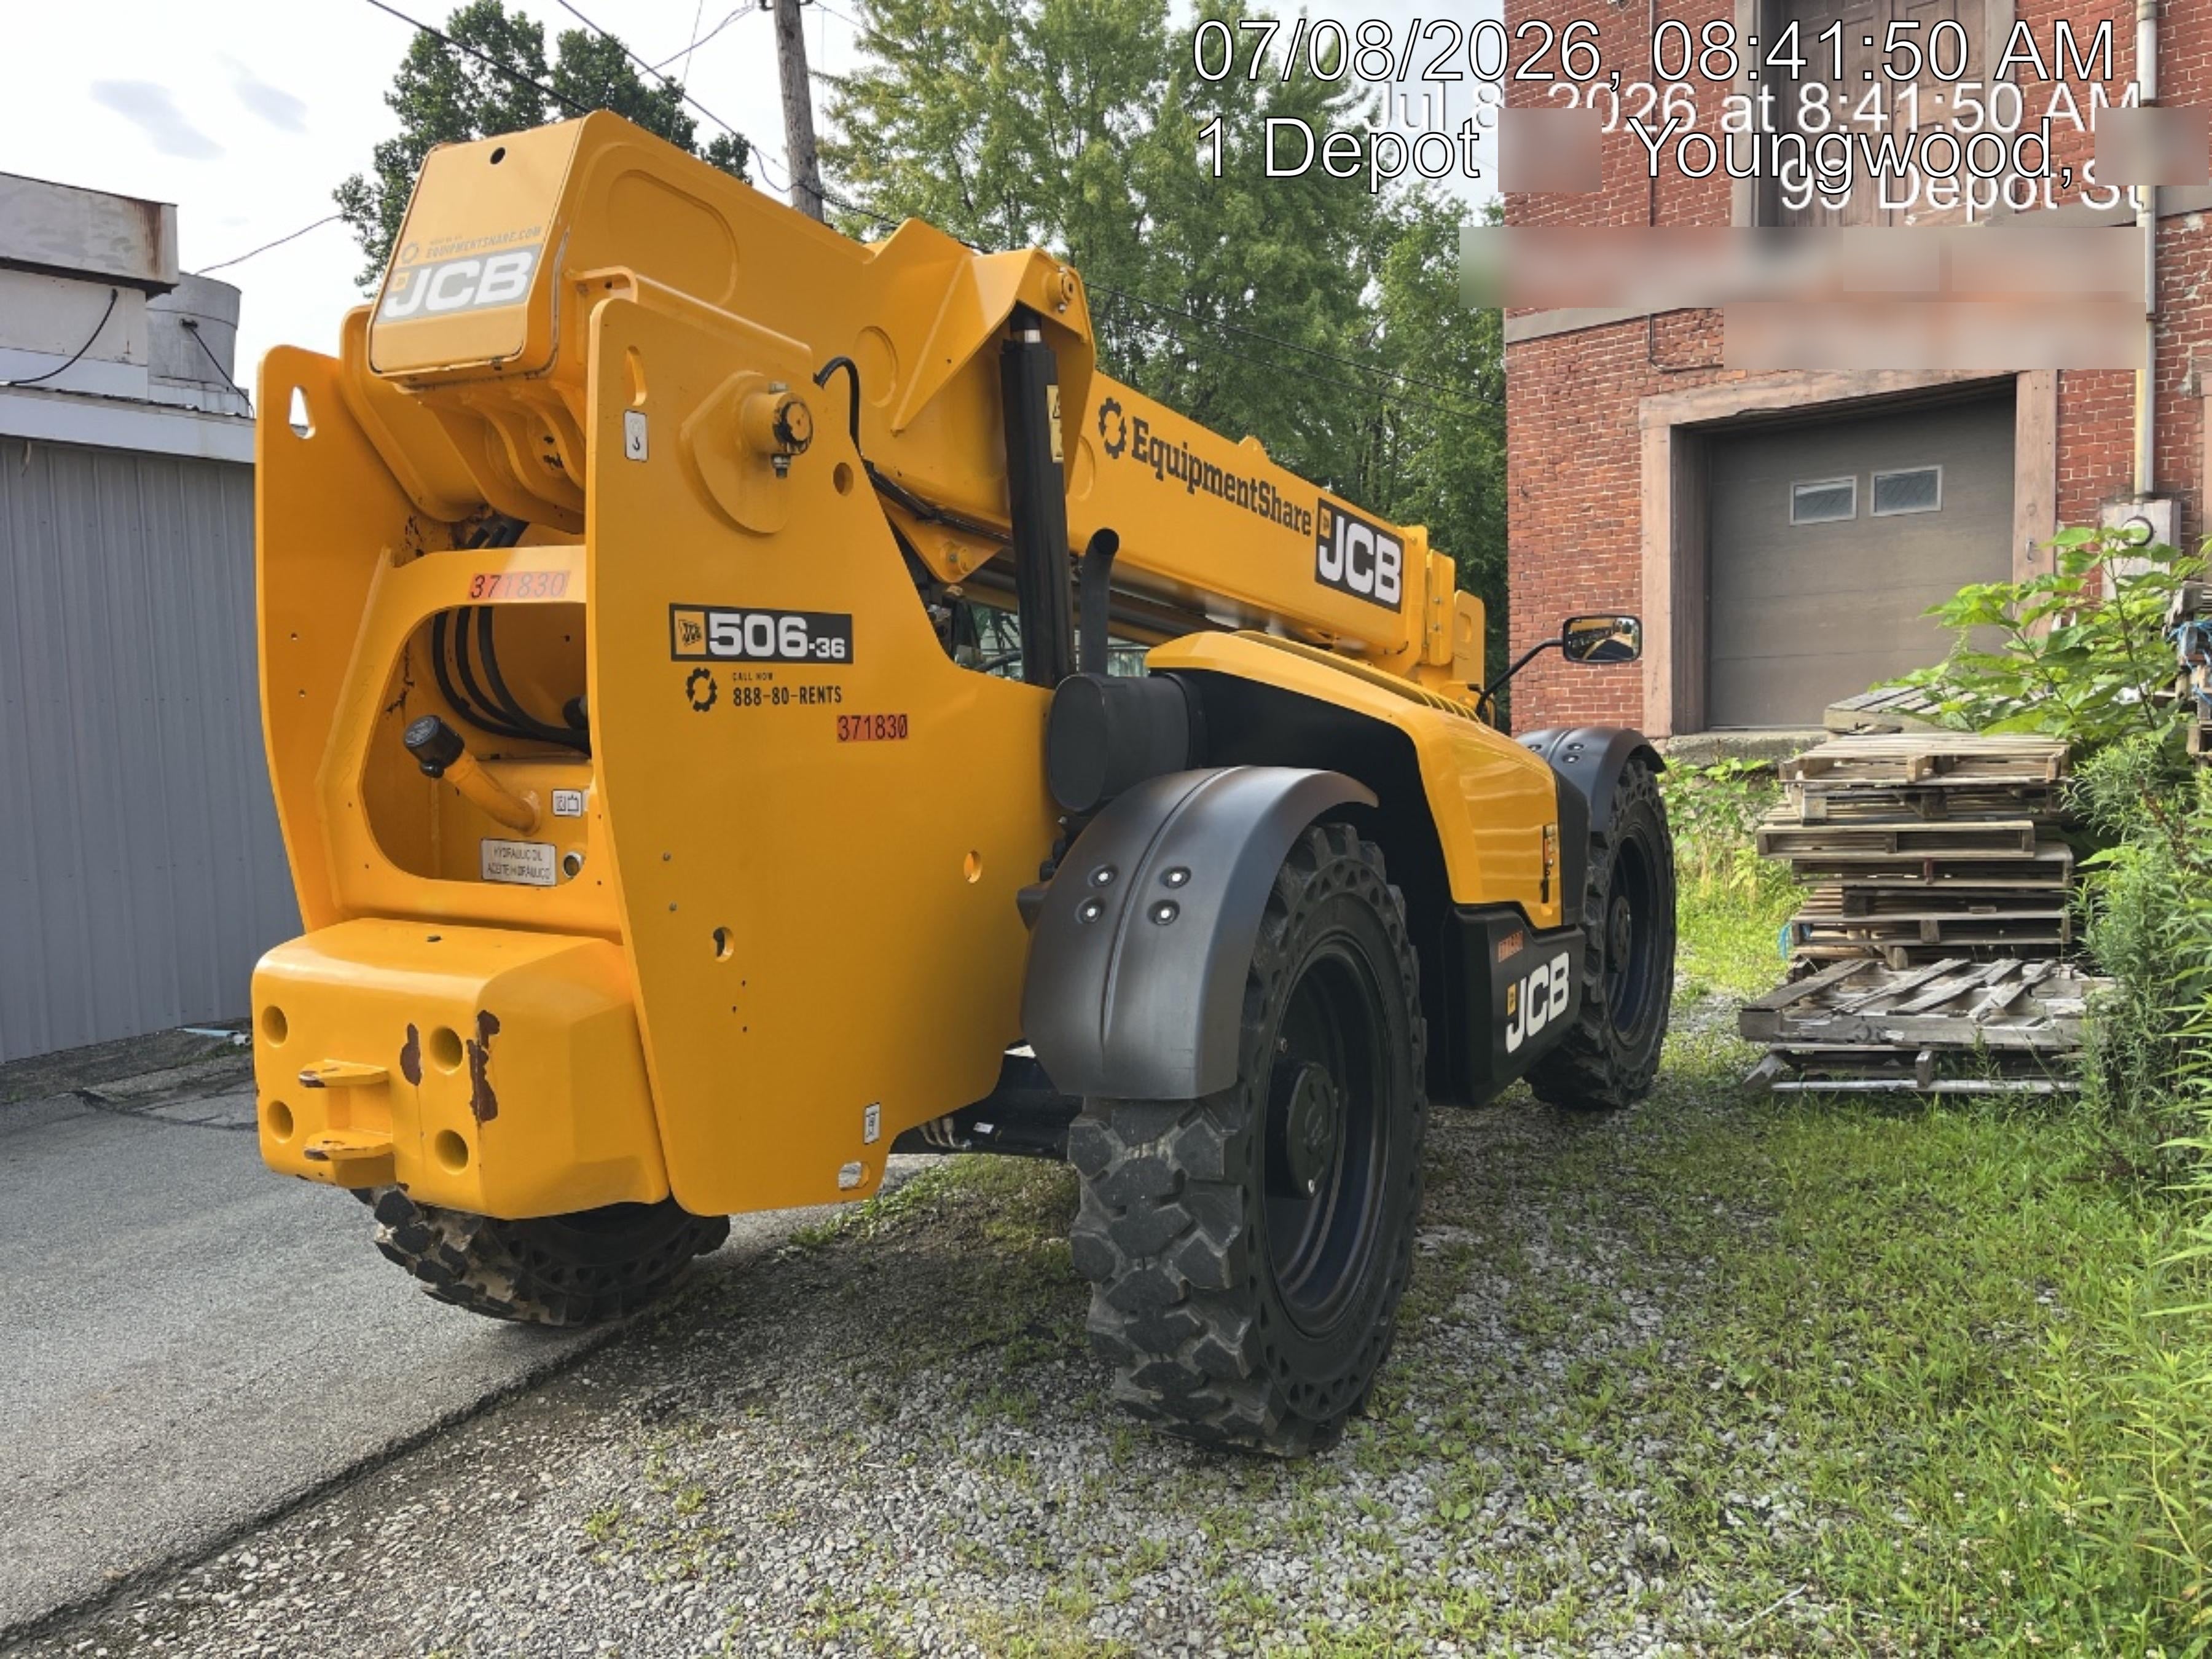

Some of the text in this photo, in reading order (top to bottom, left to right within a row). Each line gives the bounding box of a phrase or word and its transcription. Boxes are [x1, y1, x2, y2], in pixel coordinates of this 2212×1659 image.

[382, 251, 533, 318] JCB
[1131, 415, 1312, 537] EquipmentShare
[1318, 515, 1402, 605] JCB
[471, 571, 566, 600] 371830
[732, 672, 774, 681] CALL NOW
[732, 685, 842, 707] 888-80-RENTS
[837, 714, 909, 742] 371830
[1505, 951, 1570, 1054] JCB
